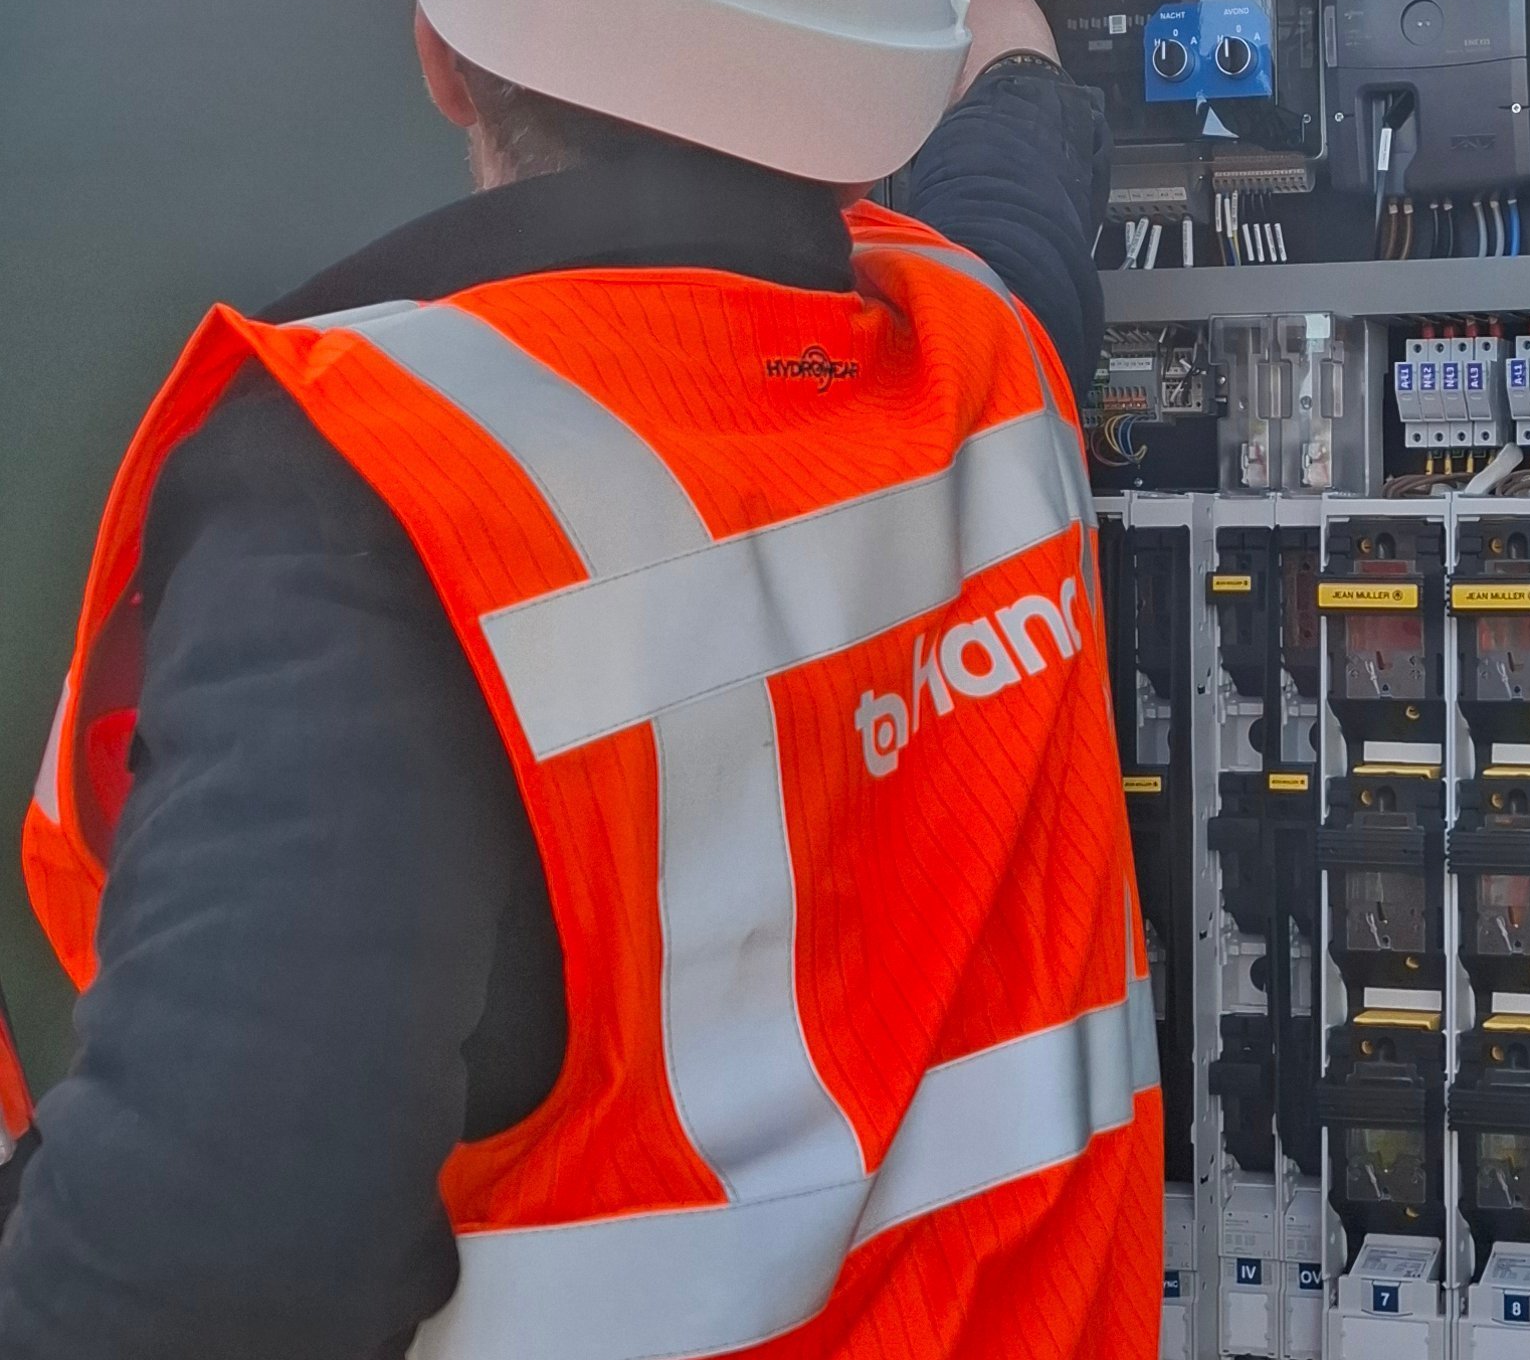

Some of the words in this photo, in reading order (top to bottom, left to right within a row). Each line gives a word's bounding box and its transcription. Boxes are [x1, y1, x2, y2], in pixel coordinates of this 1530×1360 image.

[1160, 11, 1186, 20] NACHT
[1190, 37, 1198, 45] A
[1253, 32, 1261, 41] A
[1332, 591, 1353, 599] JEAN
[1466, 591, 1488, 600] JEAN
[1241, 1265, 1257, 1279] IV
[1300, 1270, 1323, 1284] OV
[1380, 1292, 1390, 1307] 7
[1512, 1301, 1522, 1316] 8
